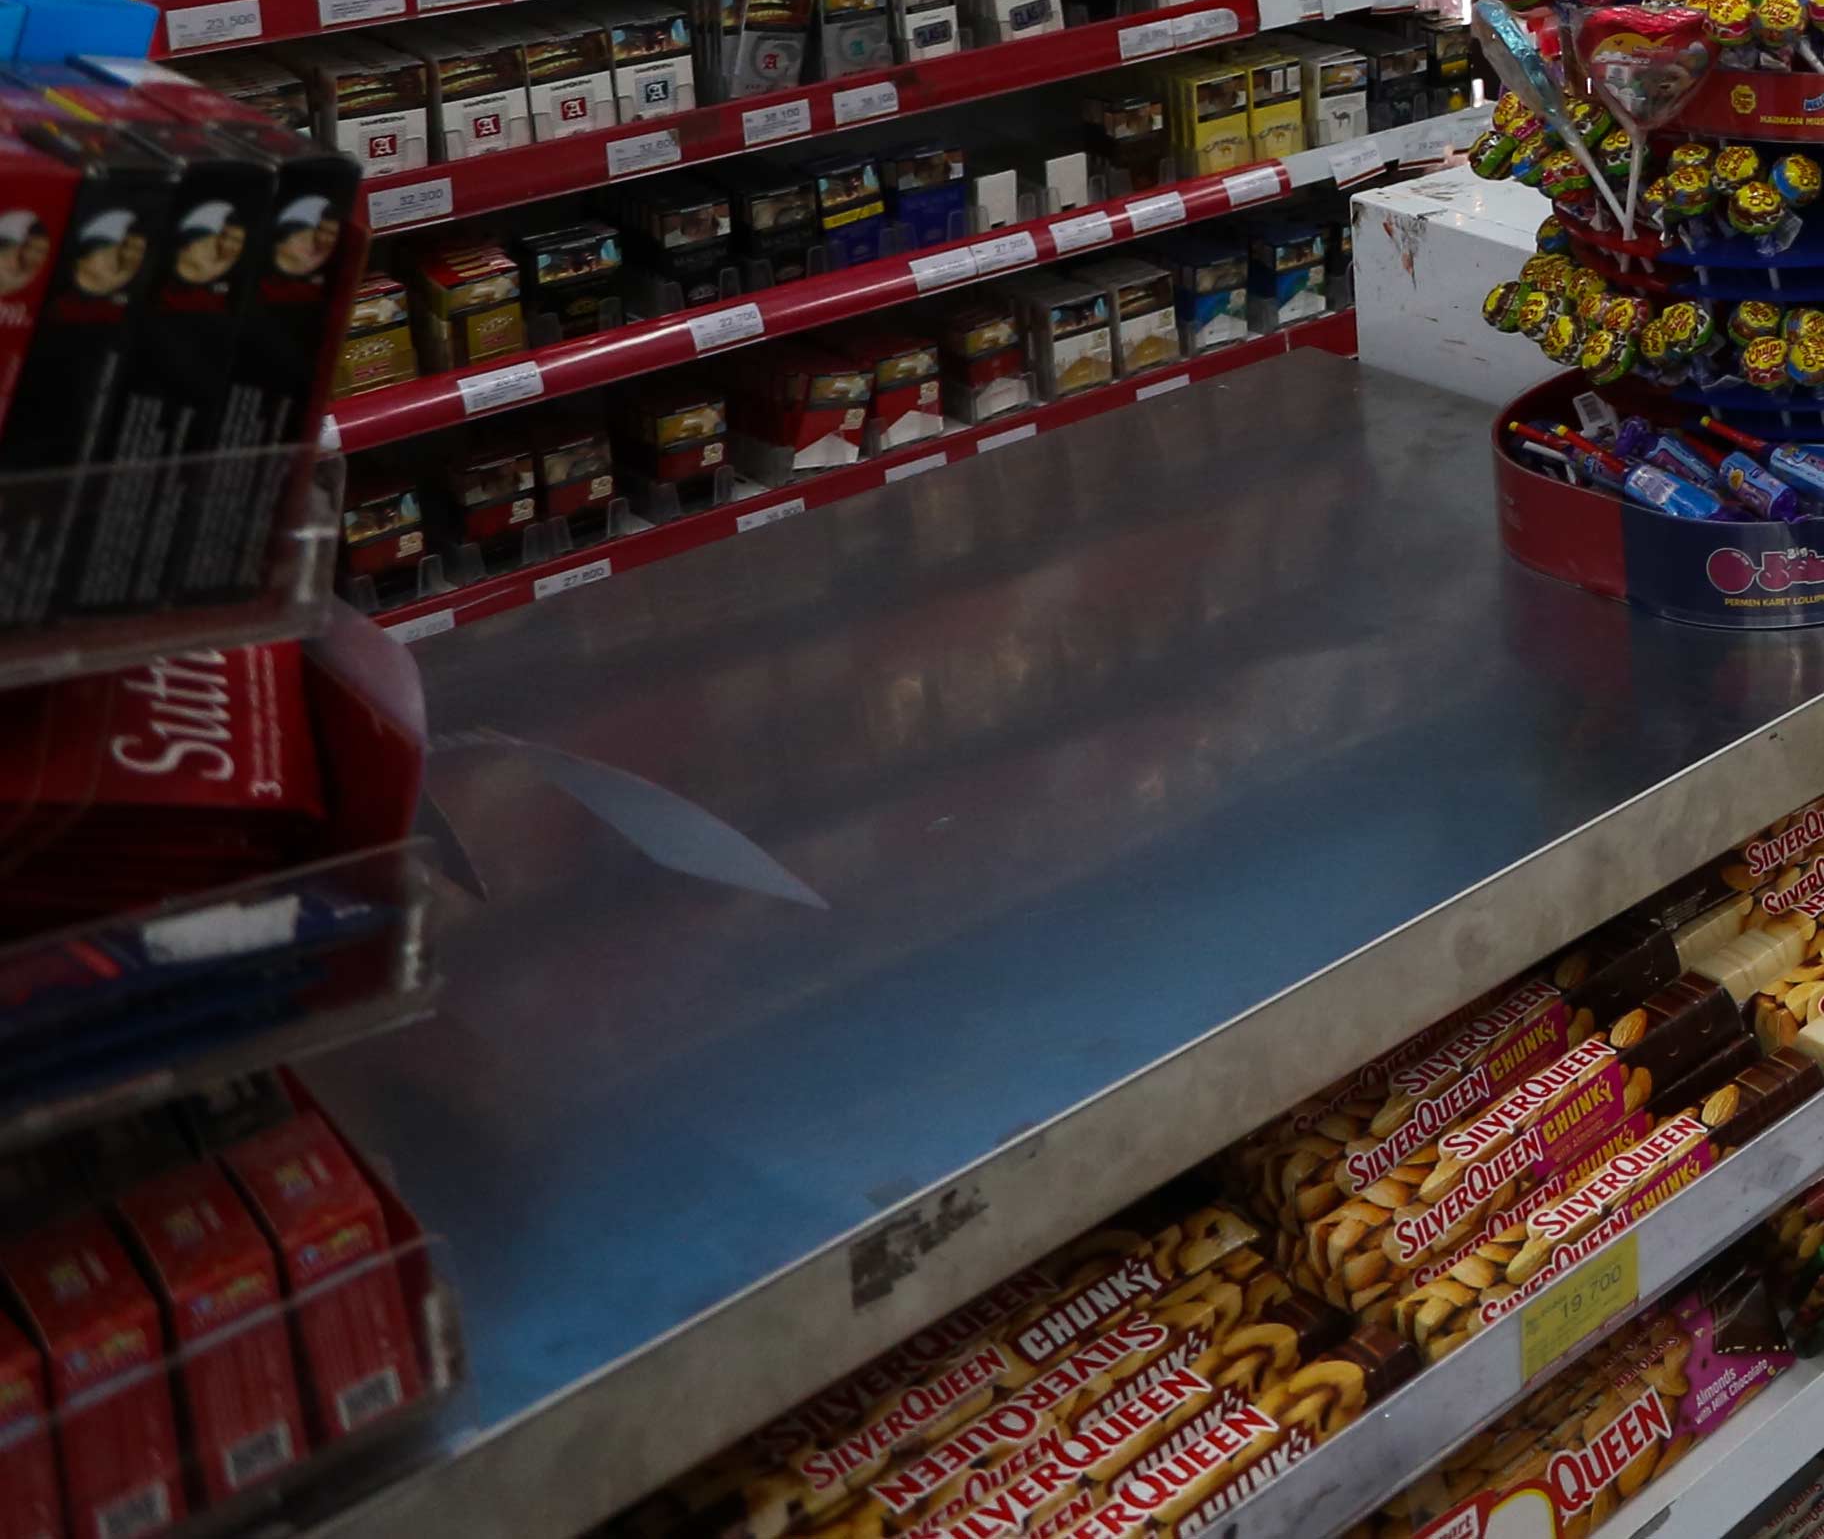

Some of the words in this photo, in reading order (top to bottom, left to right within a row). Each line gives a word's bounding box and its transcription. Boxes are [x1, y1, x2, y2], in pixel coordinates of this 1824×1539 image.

[1724, 597, 1761, 608] PERMEN
[1762, 596, 1791, 607] KARET
[1488, 1018, 1558, 1086] CHUNKY
[1542, 1073, 1615, 1141] CHUNKY
[1016, 1255, 1162, 1363] CHUNKY
[1695, 1367, 1737, 1408] Almonds
[1547, 1386, 1673, 1515] QUEEN
